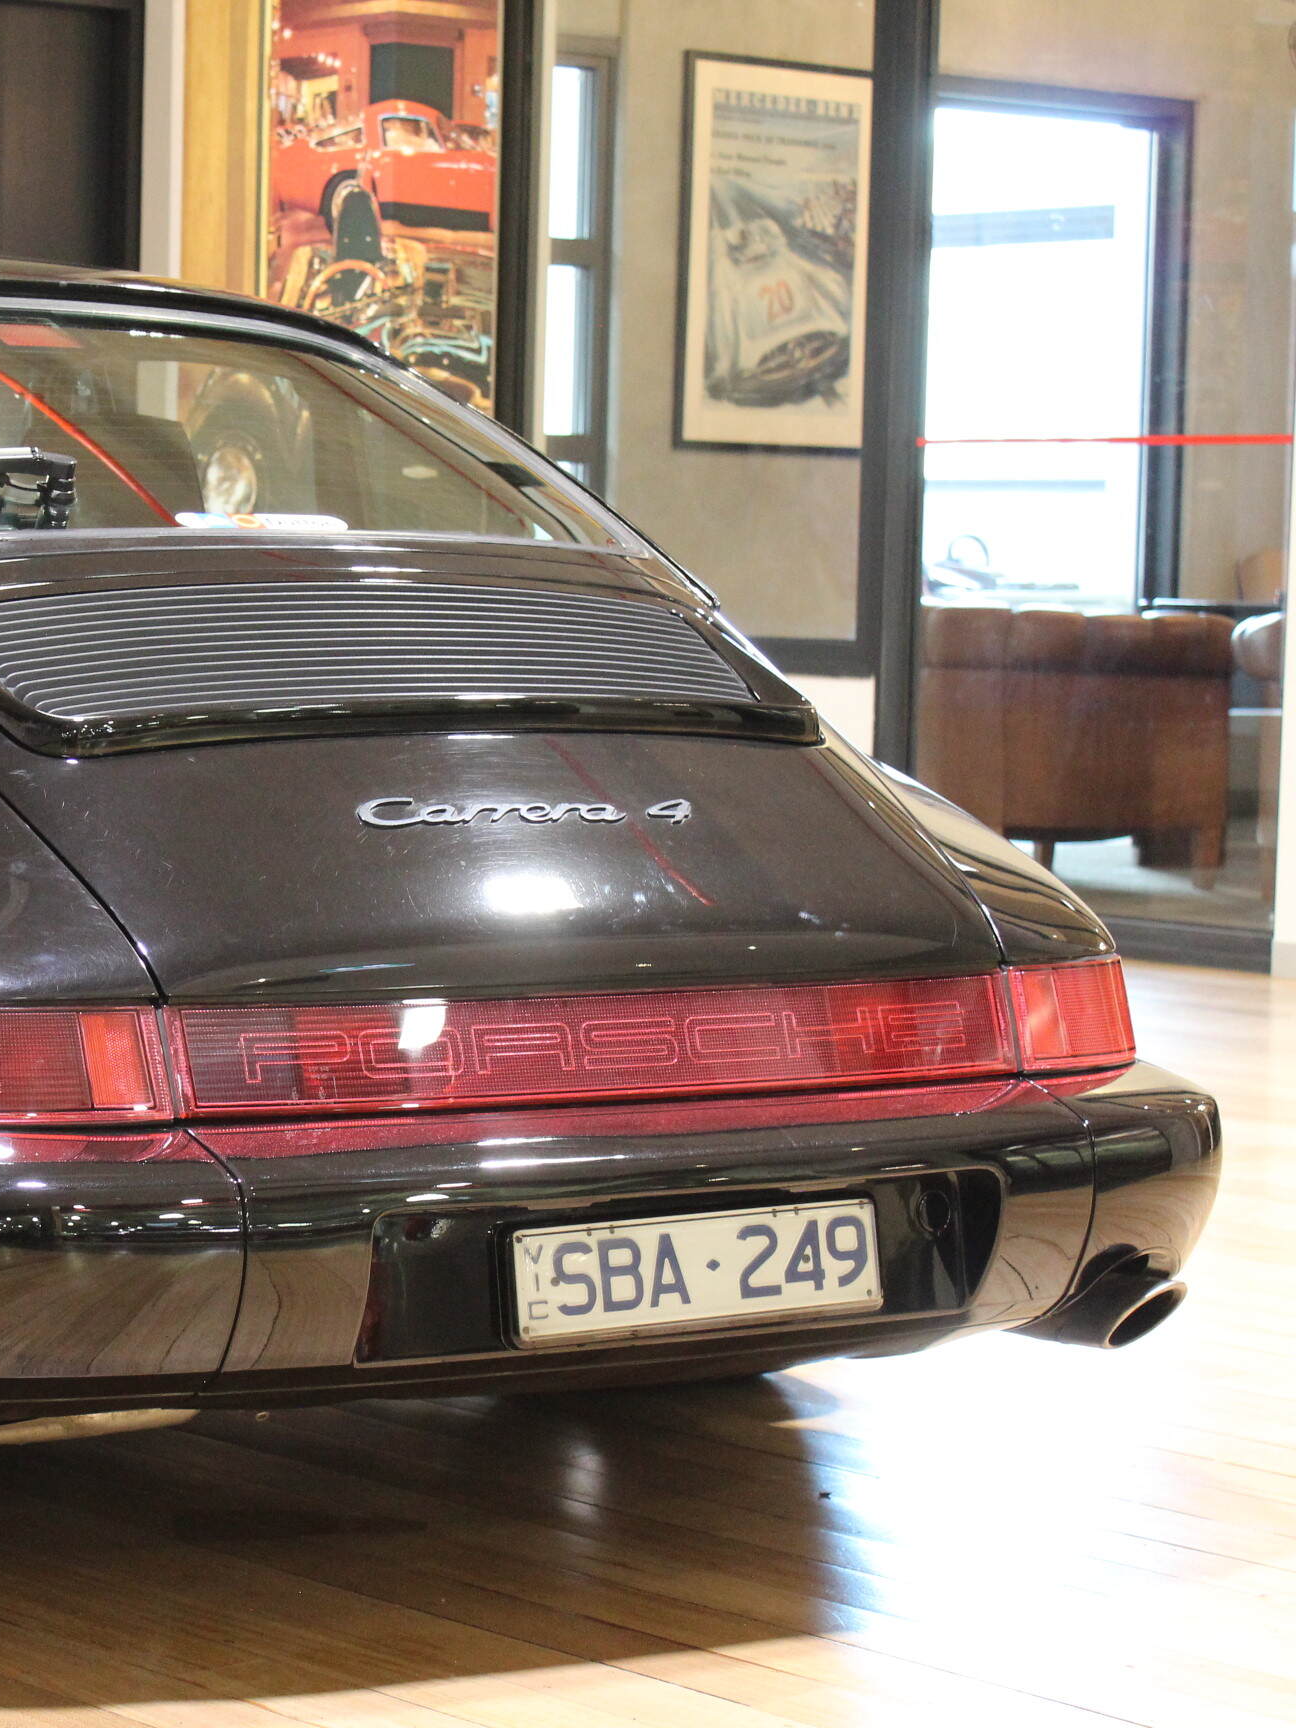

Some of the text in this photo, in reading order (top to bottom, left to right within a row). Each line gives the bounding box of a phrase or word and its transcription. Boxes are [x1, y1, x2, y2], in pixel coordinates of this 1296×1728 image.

[760, 281, 794, 322] 20
[356, 797, 691, 829] Carrera 4
[239, 1000, 966, 1084] PORSCHE
